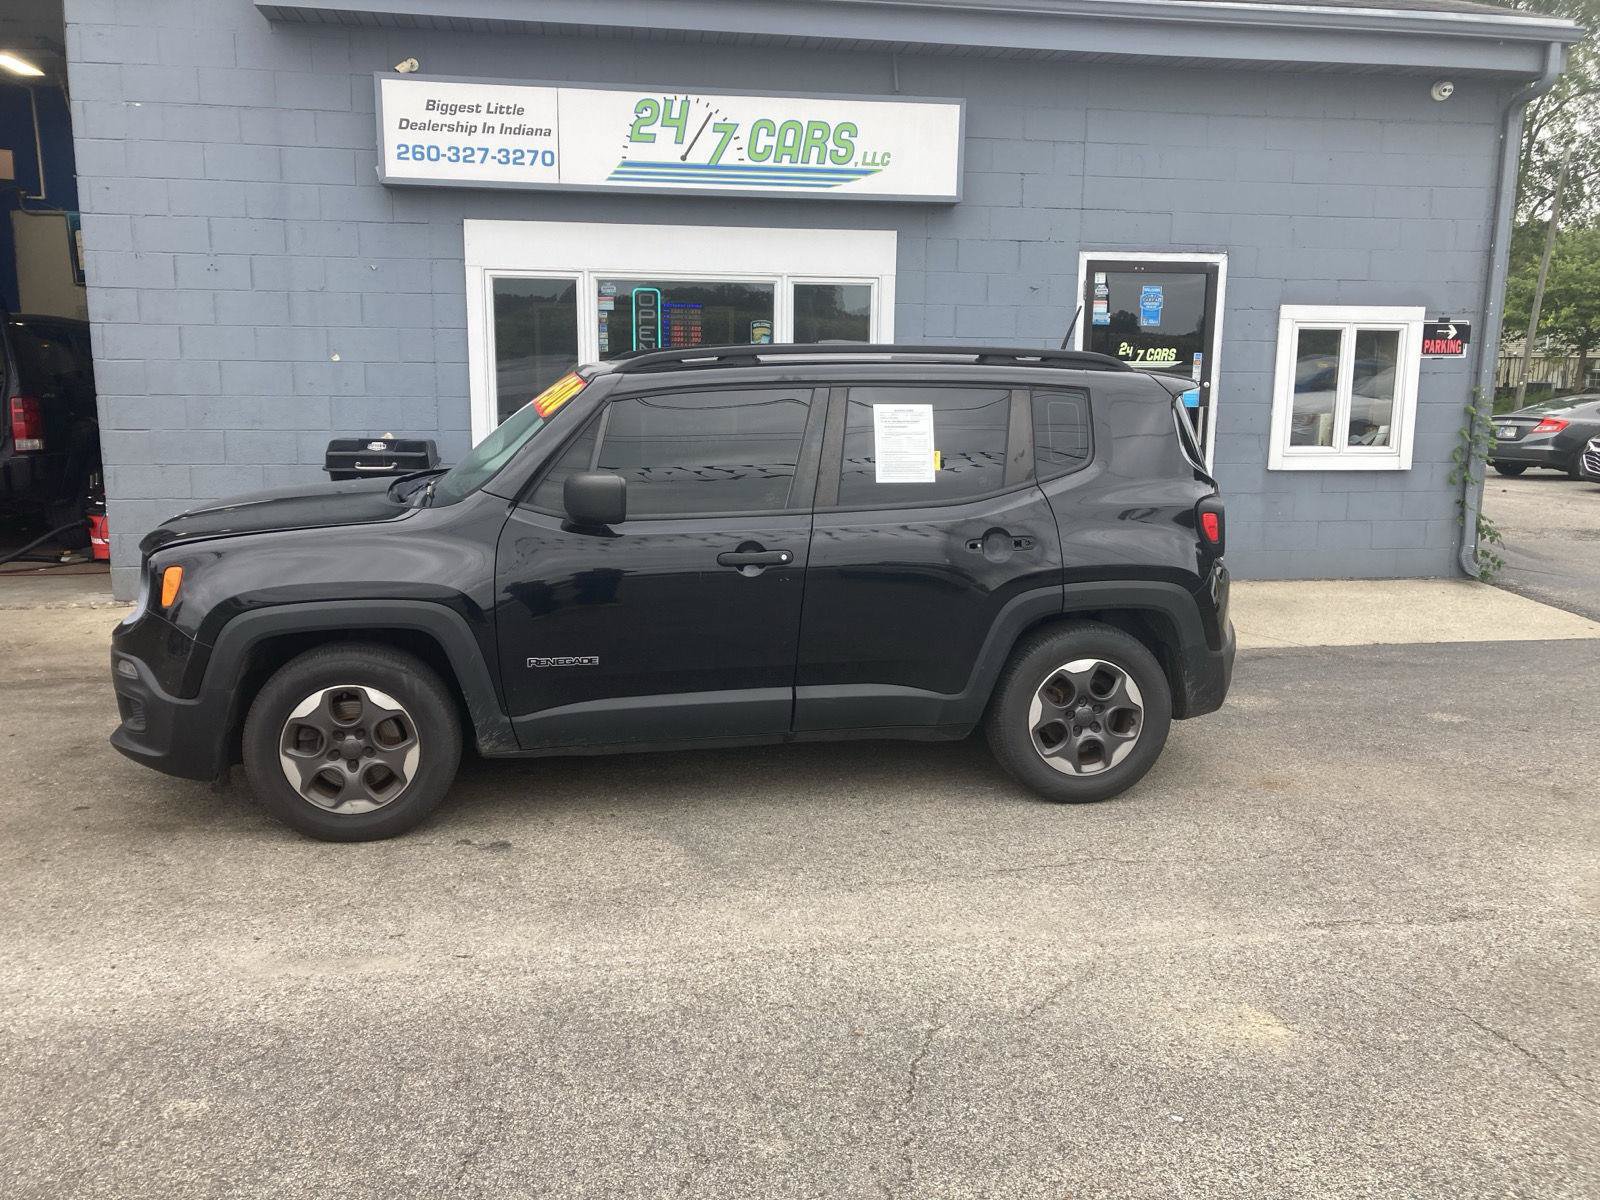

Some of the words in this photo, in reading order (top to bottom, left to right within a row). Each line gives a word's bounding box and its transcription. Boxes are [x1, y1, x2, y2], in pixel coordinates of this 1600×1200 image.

[425, 99, 482, 116] Biggest
[485, 102, 525, 116] Little
[398, 118, 478, 136] Dealership
[482, 122, 495, 134] In
[499, 123, 552, 137] Indiana
[396, 143, 555, 167] 260-327-3270
[1146, 348, 1177, 361] CARS
[1423, 339, 1462, 354] PARKING
[526, 655, 600, 668] RENEGADE
